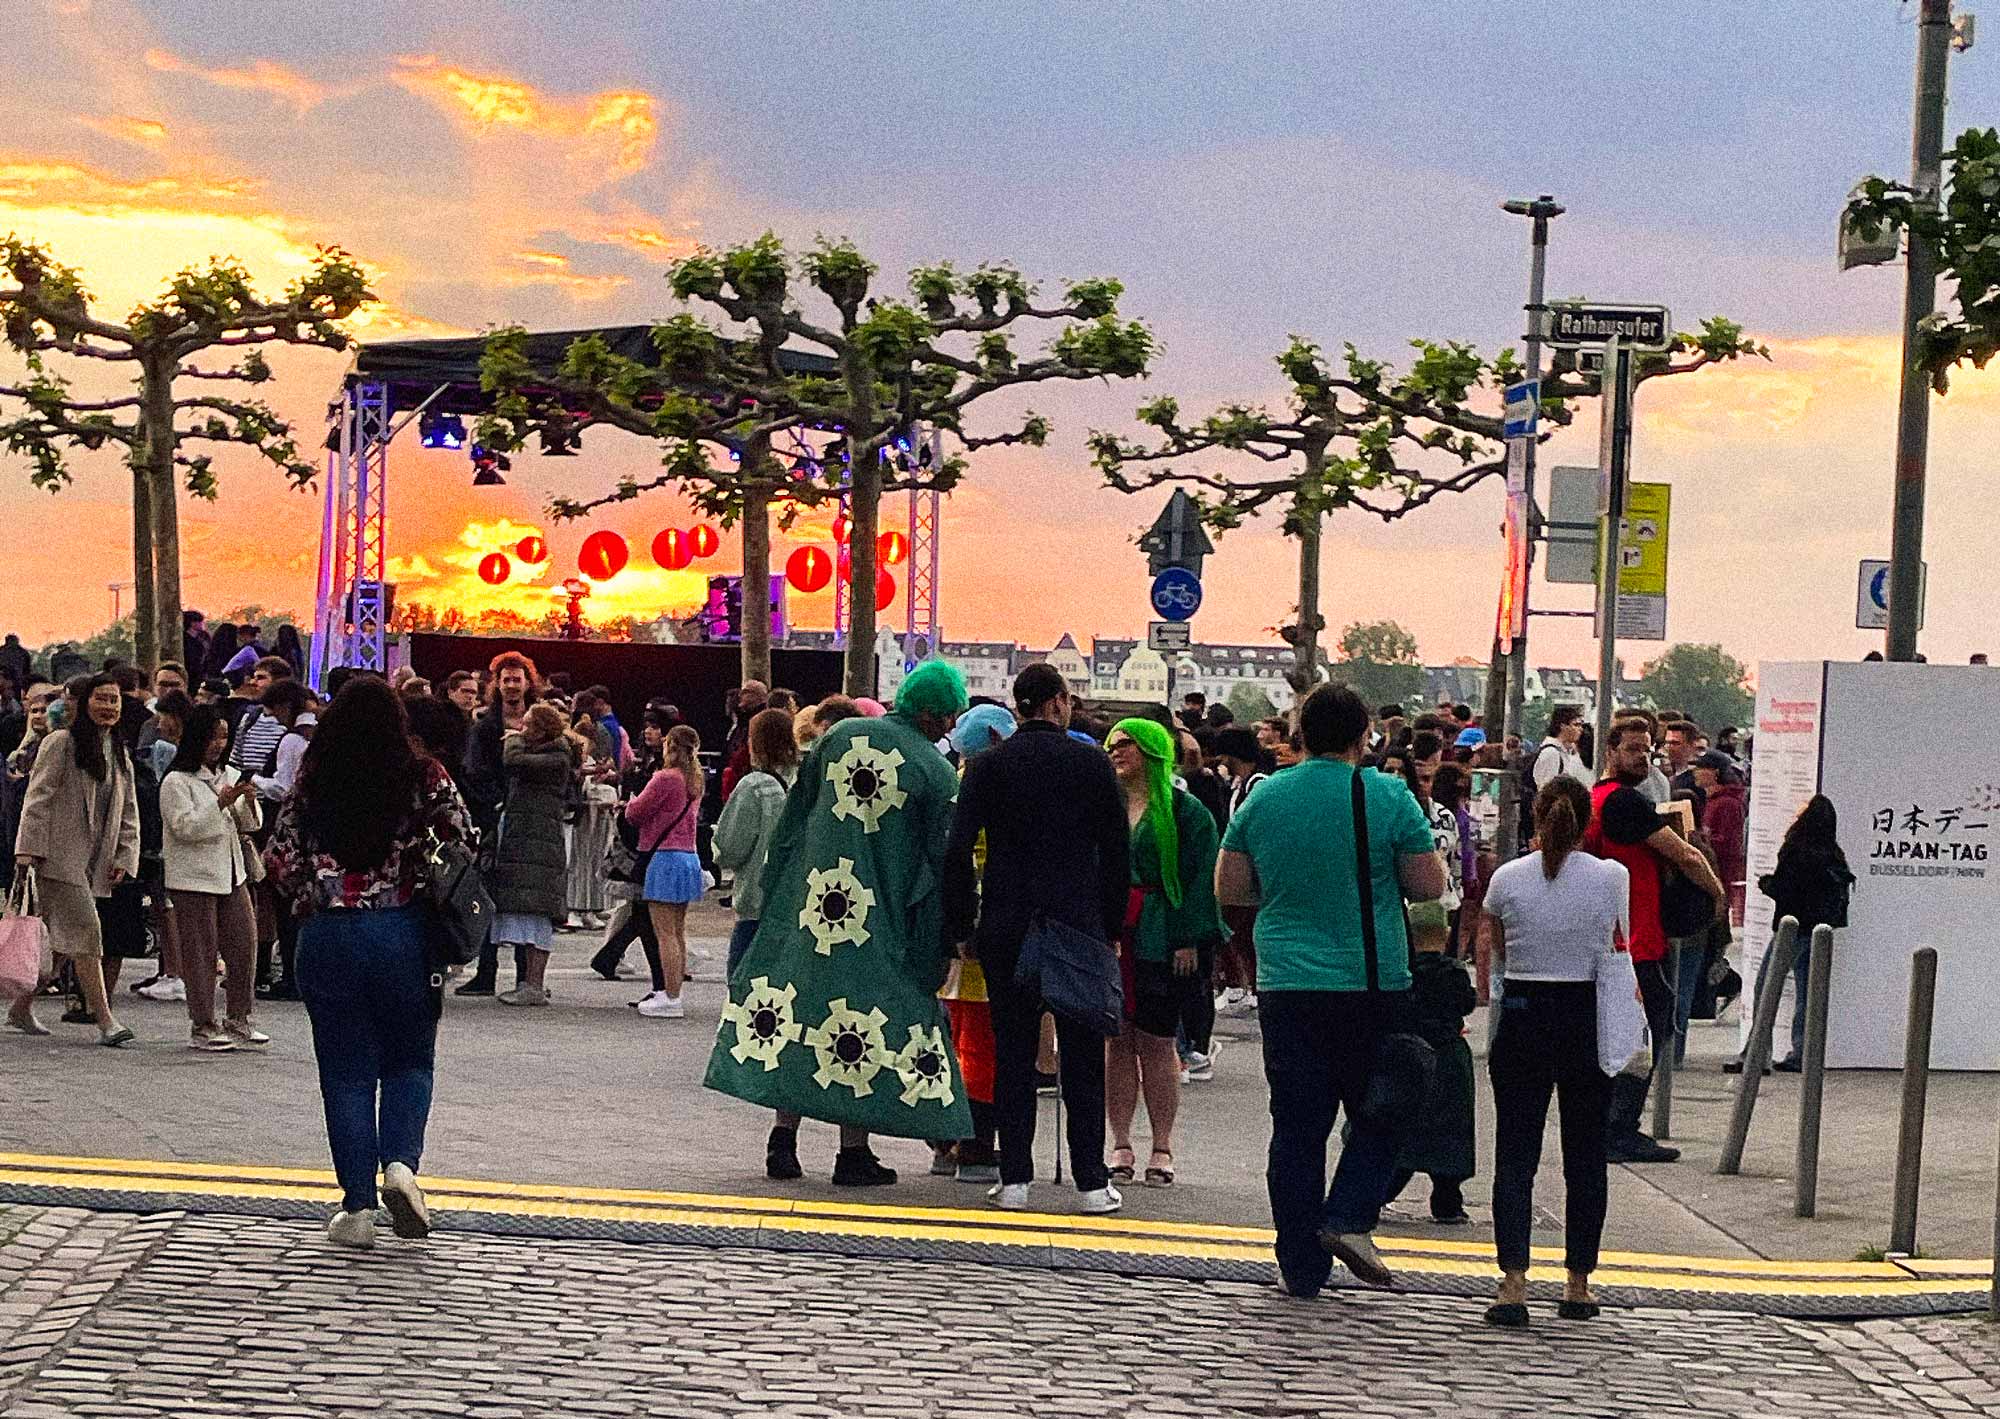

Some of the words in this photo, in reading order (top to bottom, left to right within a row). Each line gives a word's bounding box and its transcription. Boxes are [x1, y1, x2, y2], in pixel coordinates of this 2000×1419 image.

[1561, 313, 1658, 337] Rathausufer
[1872, 804, 1989, 835] 日本デー
[1870, 841, 1988, 860] JAPAN-TAG
